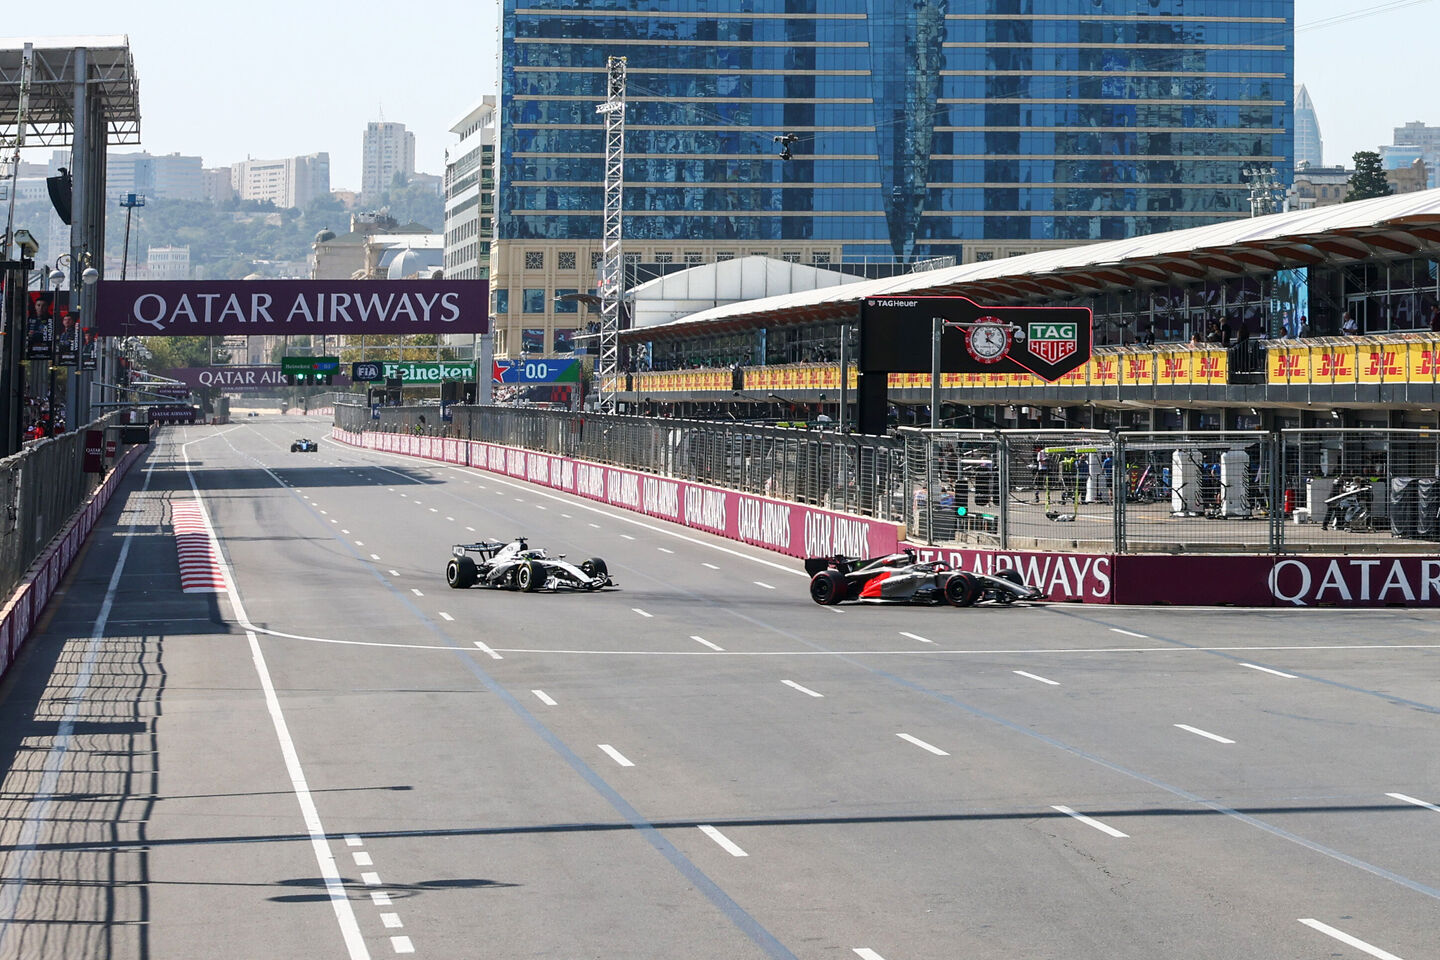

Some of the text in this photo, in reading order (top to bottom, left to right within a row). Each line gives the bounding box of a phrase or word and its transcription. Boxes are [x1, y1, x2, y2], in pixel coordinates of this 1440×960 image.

[133, 292, 460, 330] QATAR AIRWAYS
[1032, 326, 1073, 338] TAG
[1031, 341, 1074, 362] HEUER
[198, 371, 256, 387] QATAR
[358, 368, 377, 377] FIA
[385, 363, 473, 381] Heineken
[525, 363, 547, 379] 0.0
[738, 496, 790, 548] QATAR AIRWAYS
[804, 510, 870, 560] QATAR AIRWAYS
